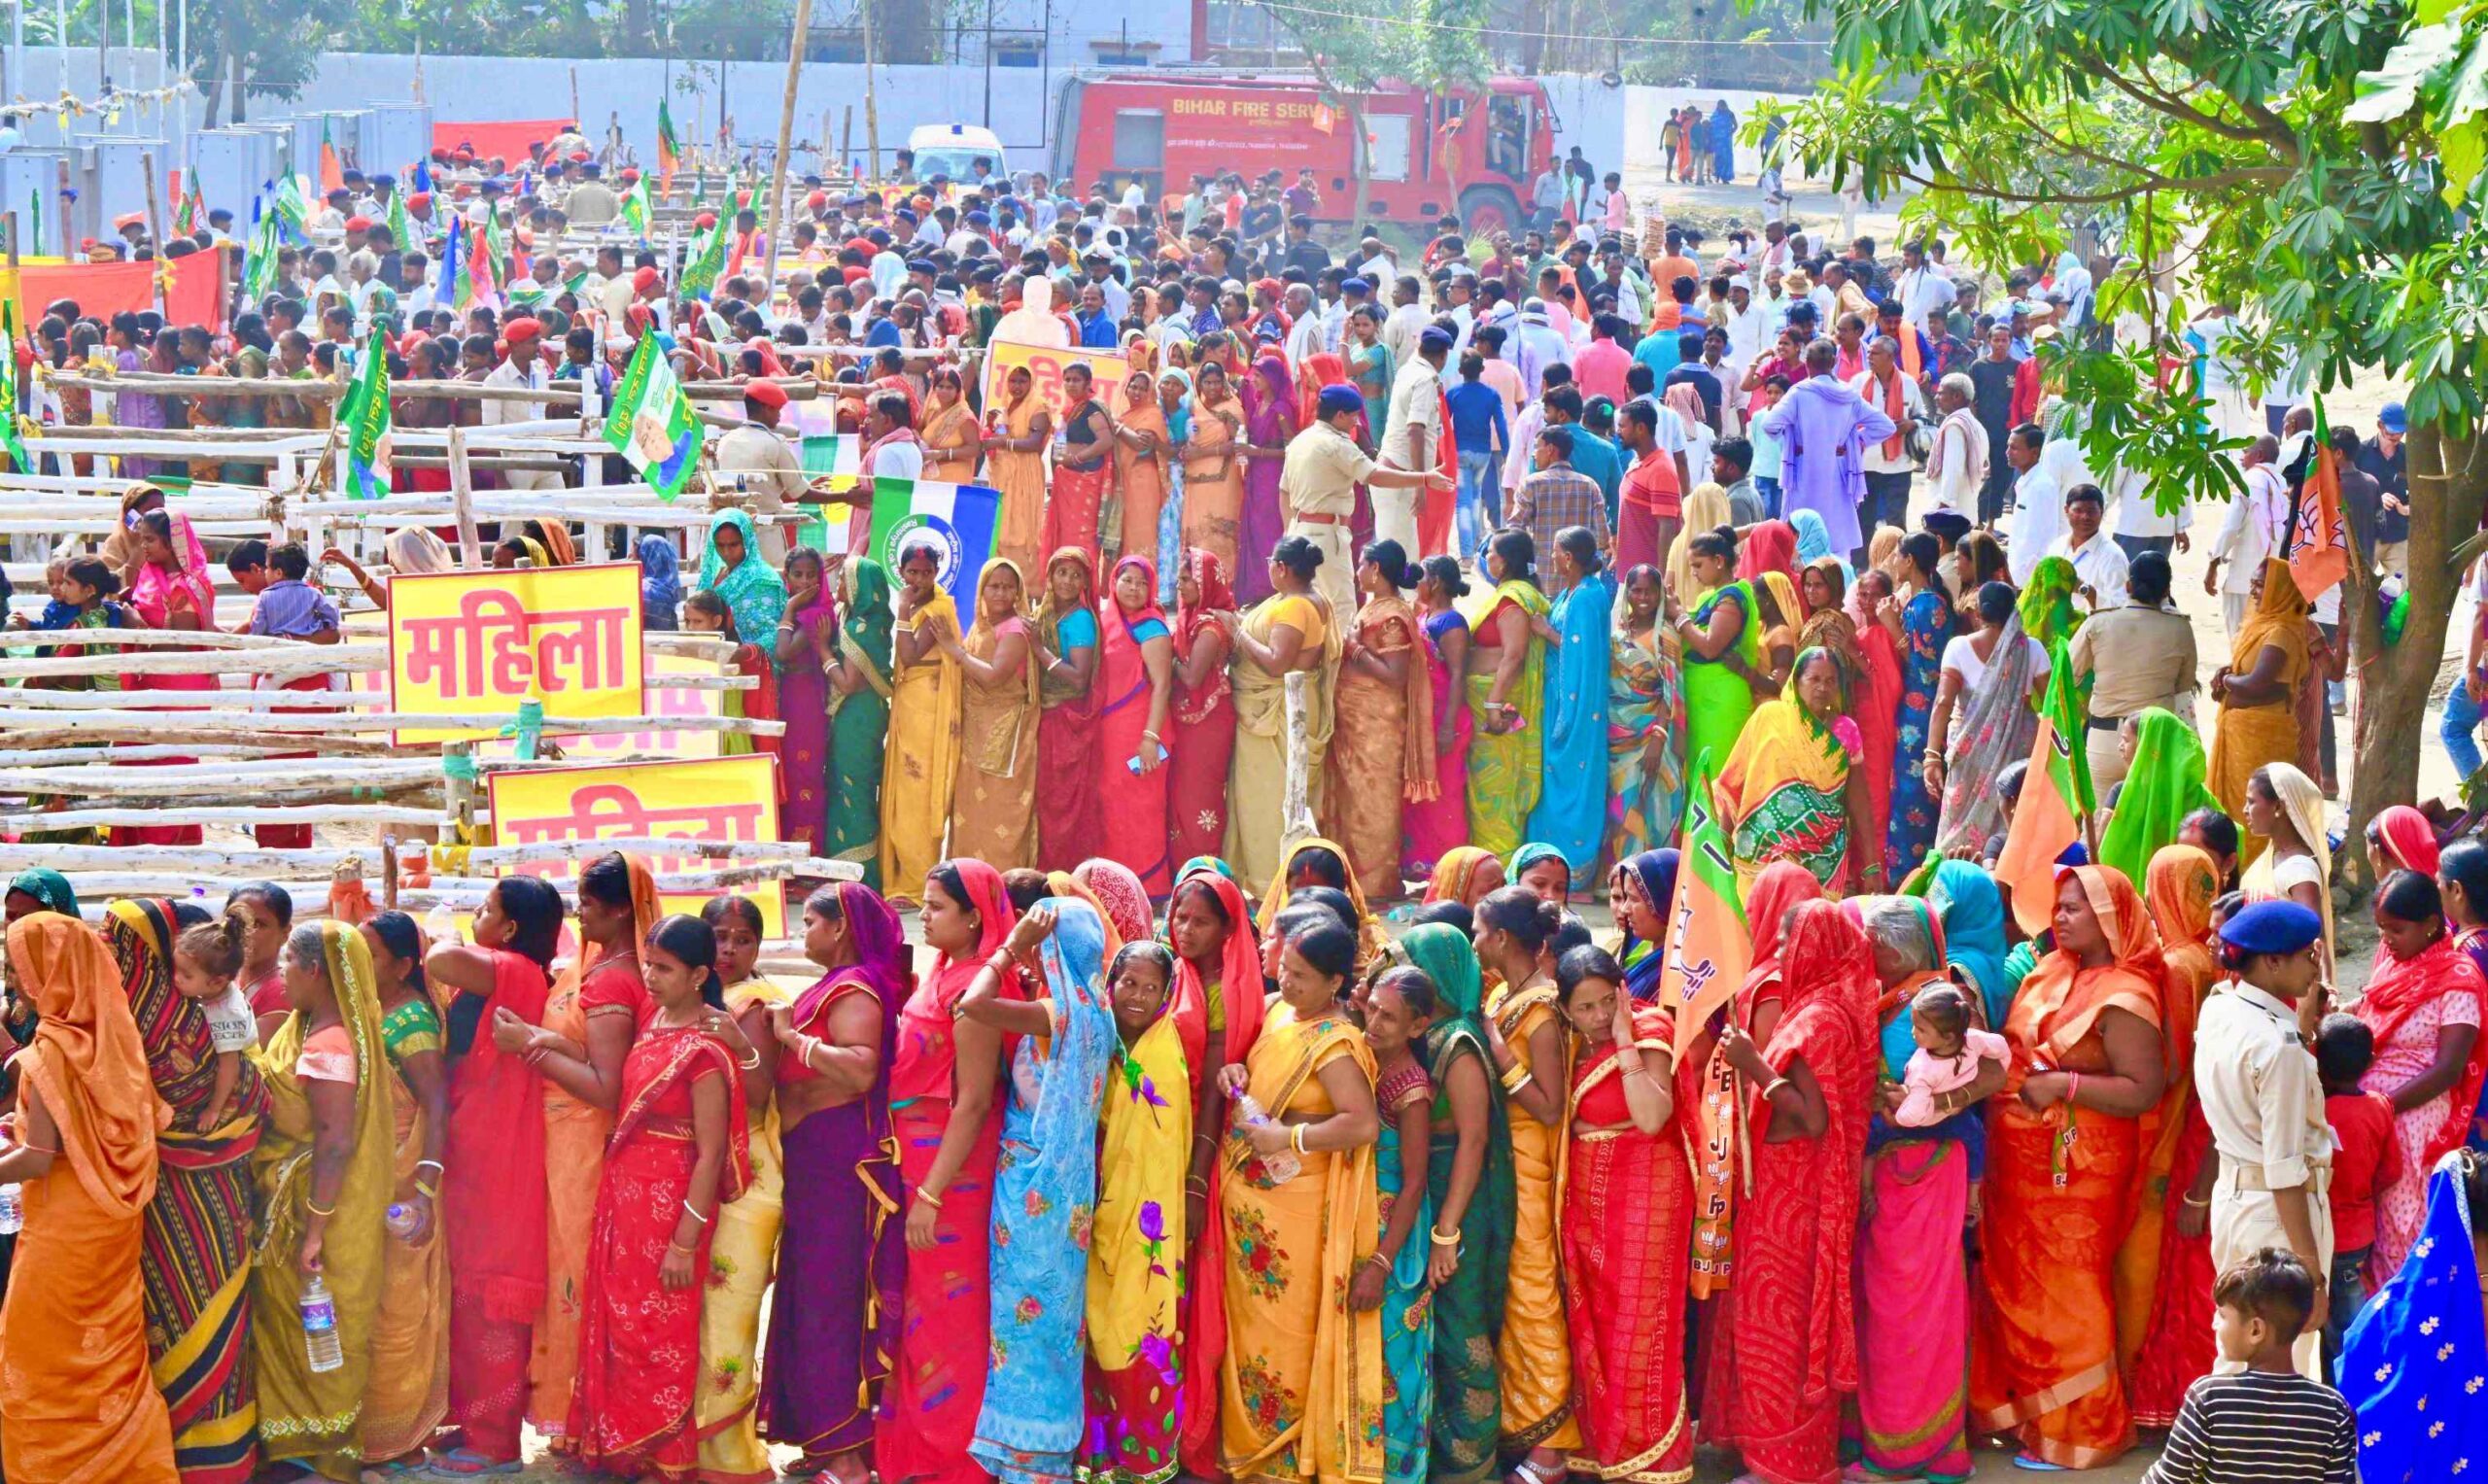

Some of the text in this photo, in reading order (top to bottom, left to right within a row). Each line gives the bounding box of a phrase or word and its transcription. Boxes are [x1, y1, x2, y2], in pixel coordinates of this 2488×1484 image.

[1172, 98, 1347, 121] BIHAR FIRE SERVE
[400, 589, 631, 699] महिला
